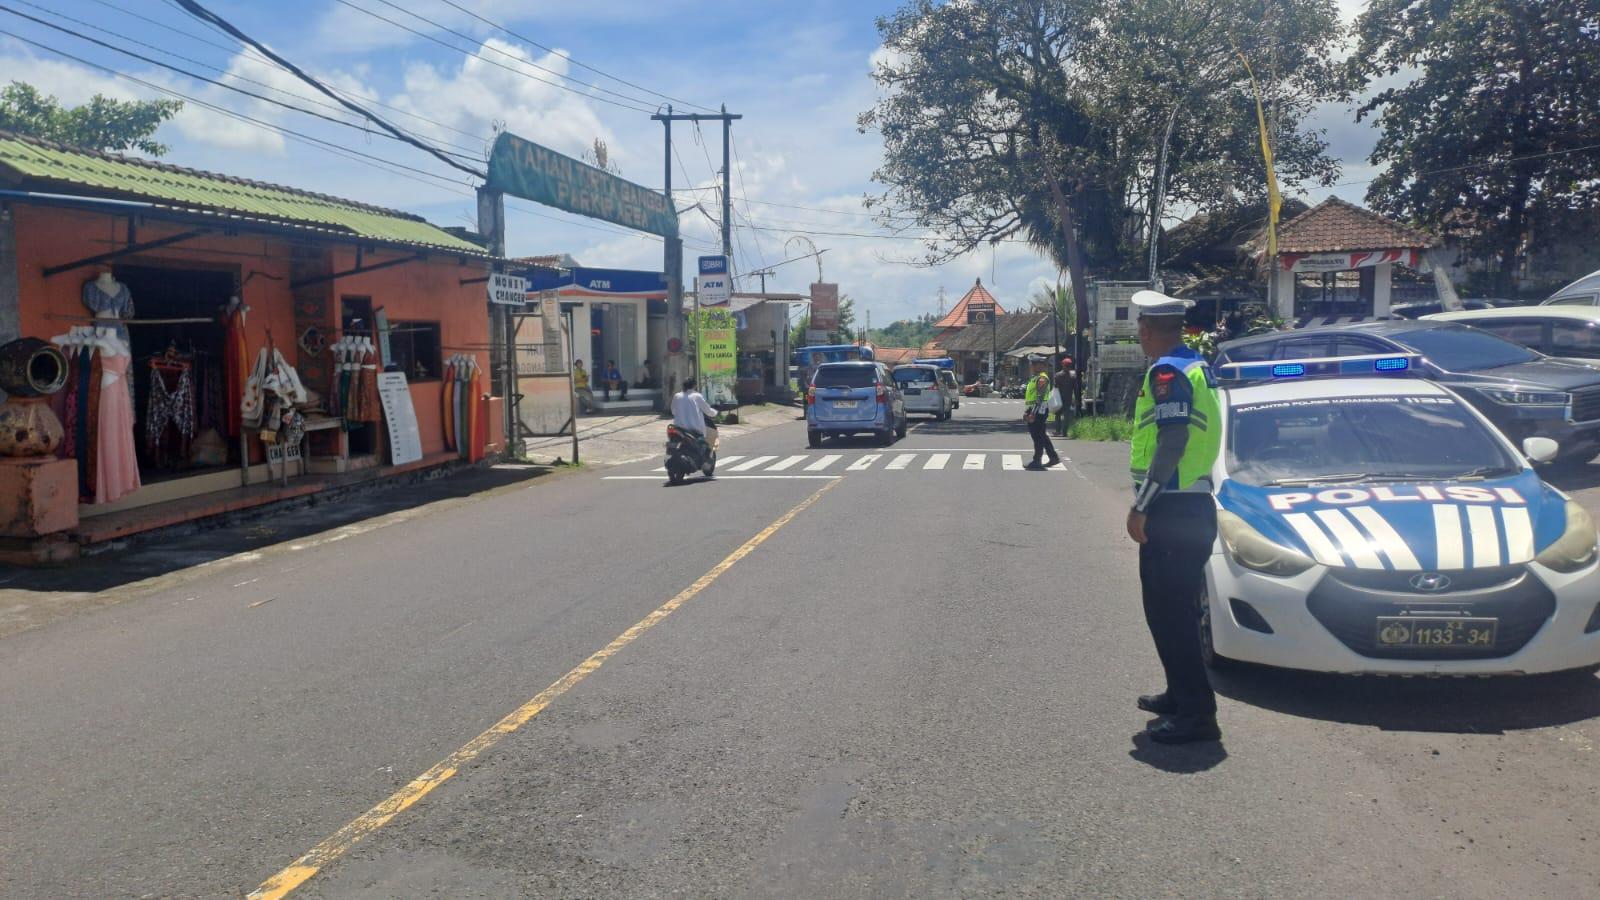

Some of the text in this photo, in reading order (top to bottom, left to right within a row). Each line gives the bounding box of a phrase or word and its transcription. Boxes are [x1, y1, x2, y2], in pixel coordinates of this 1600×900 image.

[509, 138, 573, 184] TAMAN
[495, 276, 524, 290] MONEY
[589, 280, 611, 288] ATM
[496, 290, 525, 303] CHANGER
[270, 445, 299, 460] CHAGER
[1267, 486, 1527, 510] POLISI
